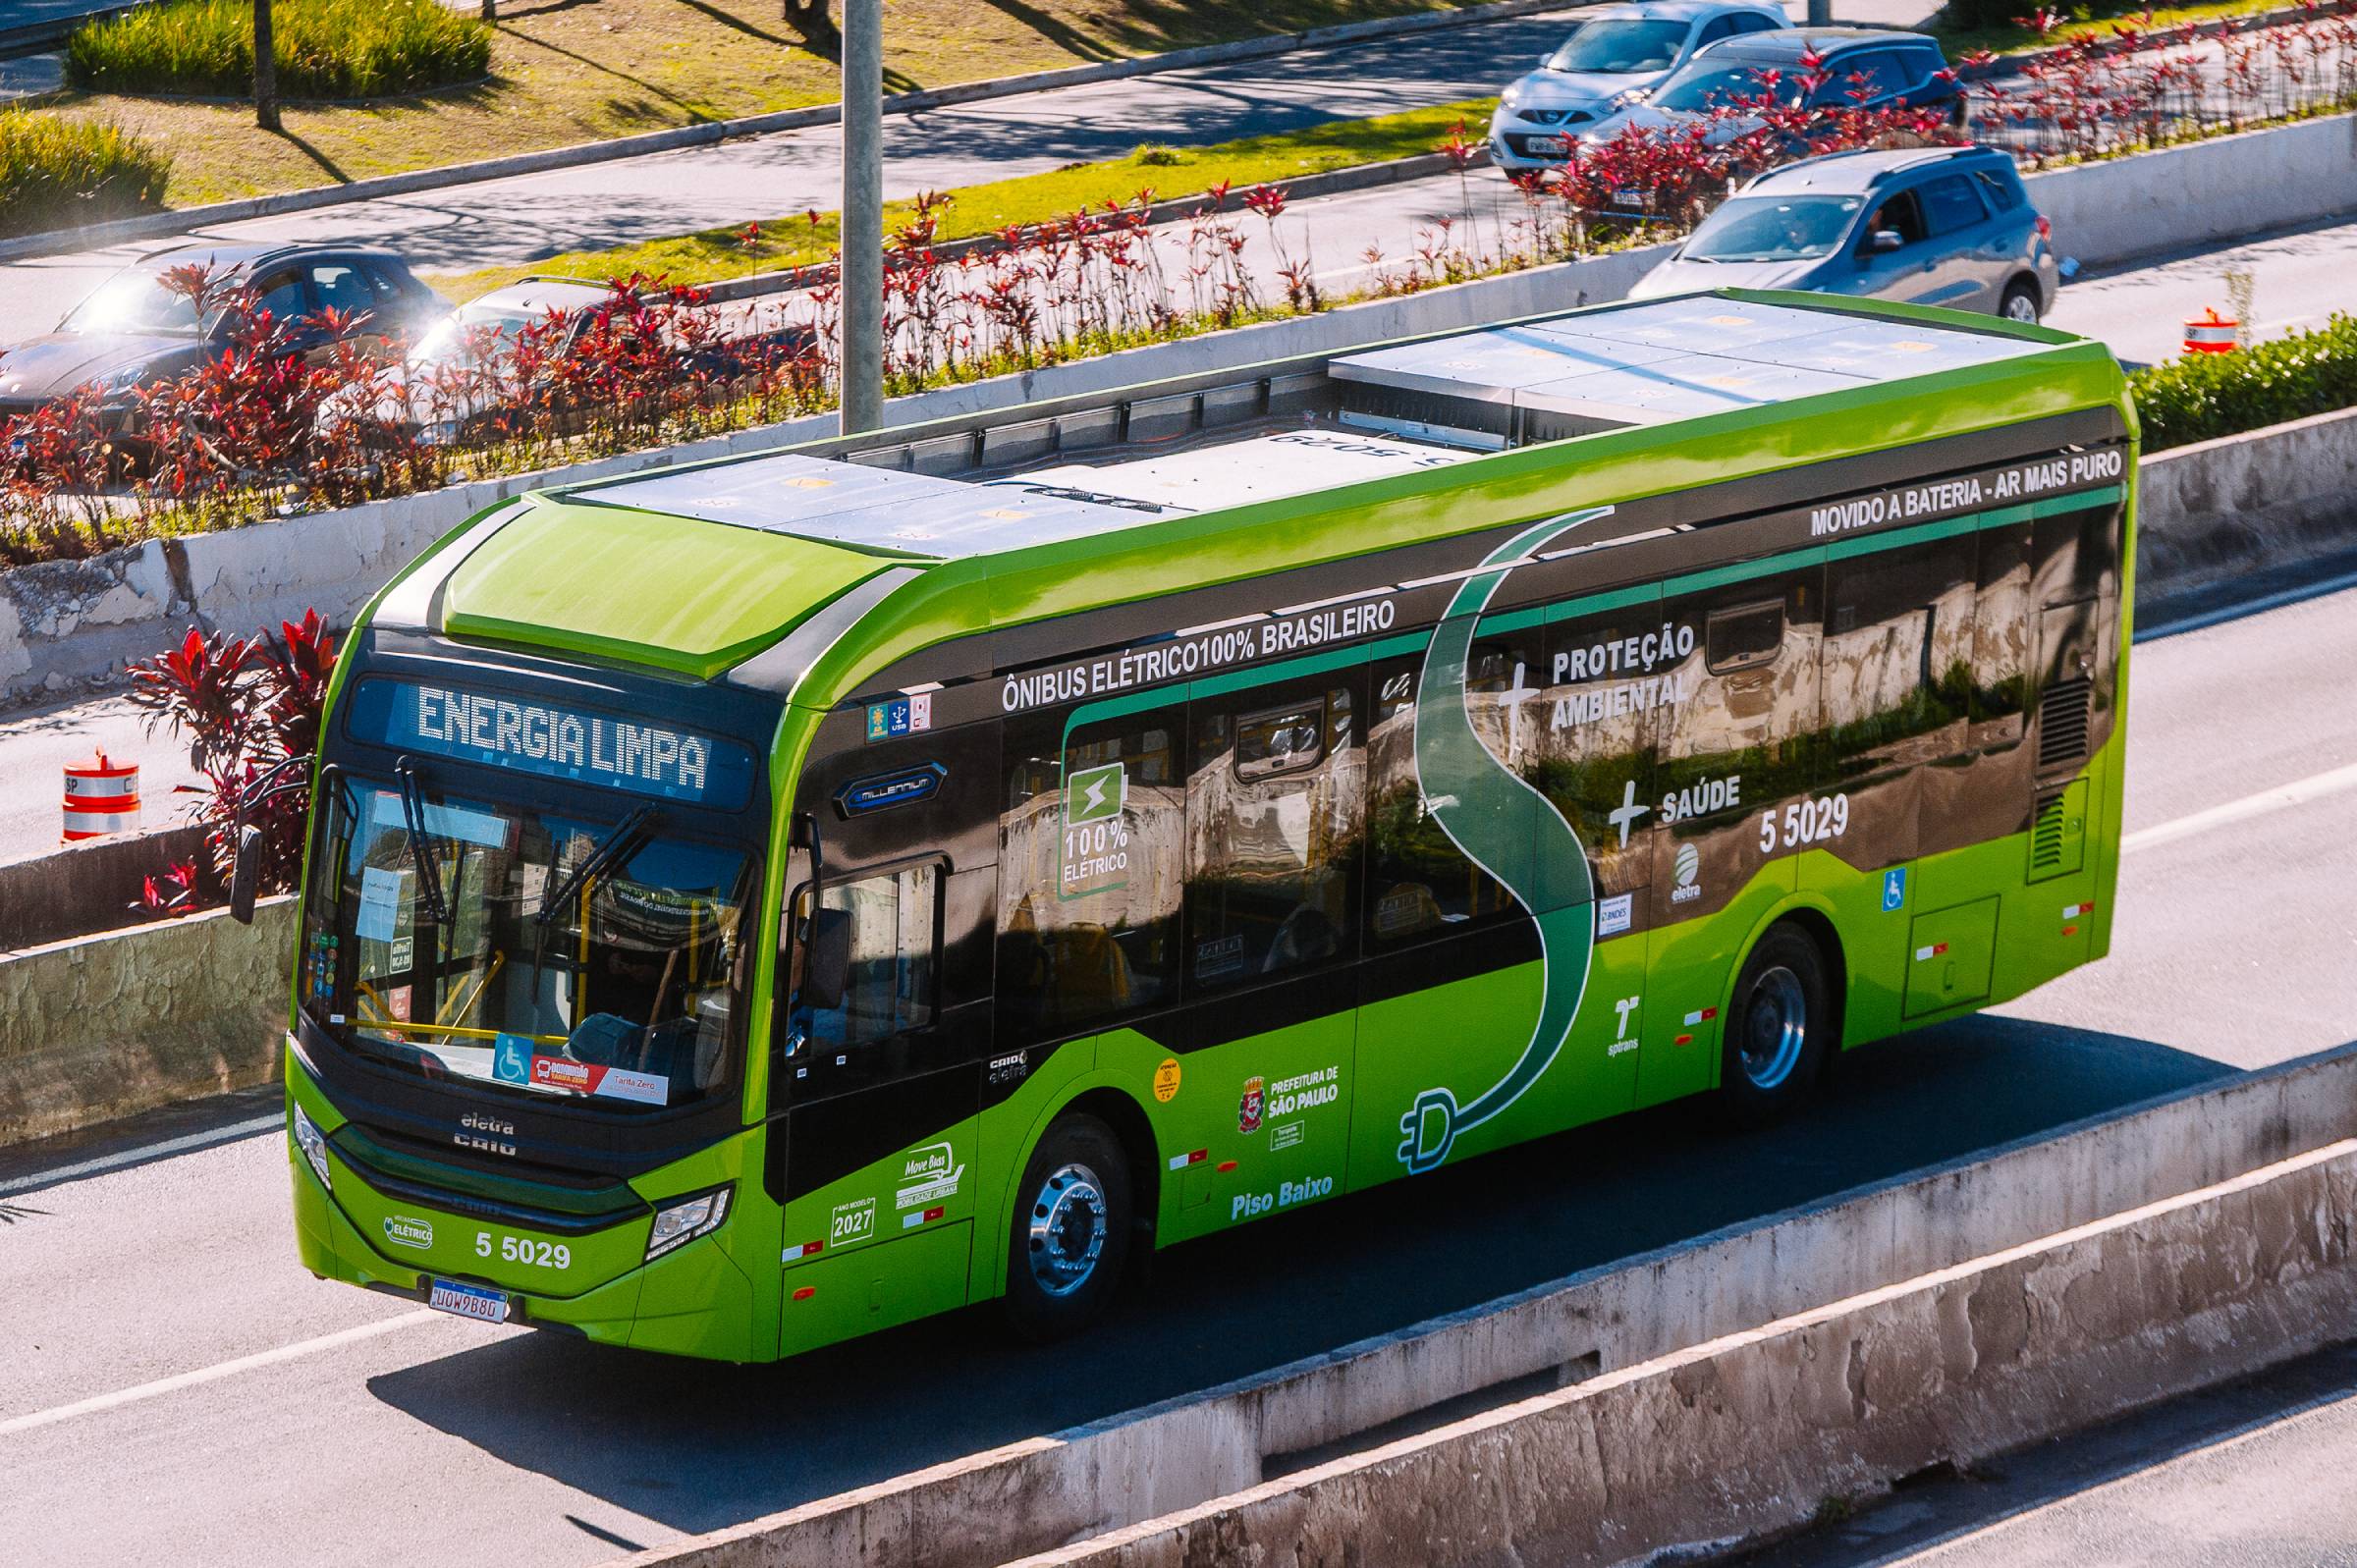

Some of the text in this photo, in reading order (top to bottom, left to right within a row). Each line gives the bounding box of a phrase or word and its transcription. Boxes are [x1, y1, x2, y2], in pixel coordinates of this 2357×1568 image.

[1811, 496, 1885, 536] MOVIDO
[1888, 494, 1902, 521] A
[1904, 479, 1982, 516] BATERIA
[1995, 471, 2021, 499] AR
[2024, 460, 2067, 492] MAIS
[2070, 450, 2122, 484] PURO
[1002, 665, 1087, 712] ÔNIBUS
[1261, 600, 1396, 655] BRASILEIRO
[1553, 623, 1694, 684] PROTEÇÃO
[1550, 674, 1688, 731] AMBIENTAL
[418, 685, 705, 788] ENERGIA LIMPA
[1662, 775, 1740, 824] SAÚDE
[1066, 820, 1128, 860] 100%
[1759, 792, 1849, 854] 5 5029
[1064, 849, 1127, 883] ELÉTRICO
[1672, 884, 1701, 901] eletra
[1607, 907, 1626, 920] BNDES
[1608, 1038, 1638, 1057] sptrans
[551, 1073, 571, 1083] TARIFA
[572, 1076, 588, 1085] ZERO
[614, 1075, 655, 1090] Tarifa Zero
[1271, 1065, 1339, 1096] PREFEITURA DE
[1269, 1084, 1339, 1118] SÃO PAULO
[905, 1159, 927, 1176] Move
[838, 1197, 871, 1212] ANO MODELO
[1232, 1176, 1333, 1220] Piso Baixo
[394, 1223, 432, 1242] ELÉTRICO
[835, 1209, 872, 1237] 2027
[475, 1232, 571, 1270] 5 5029
